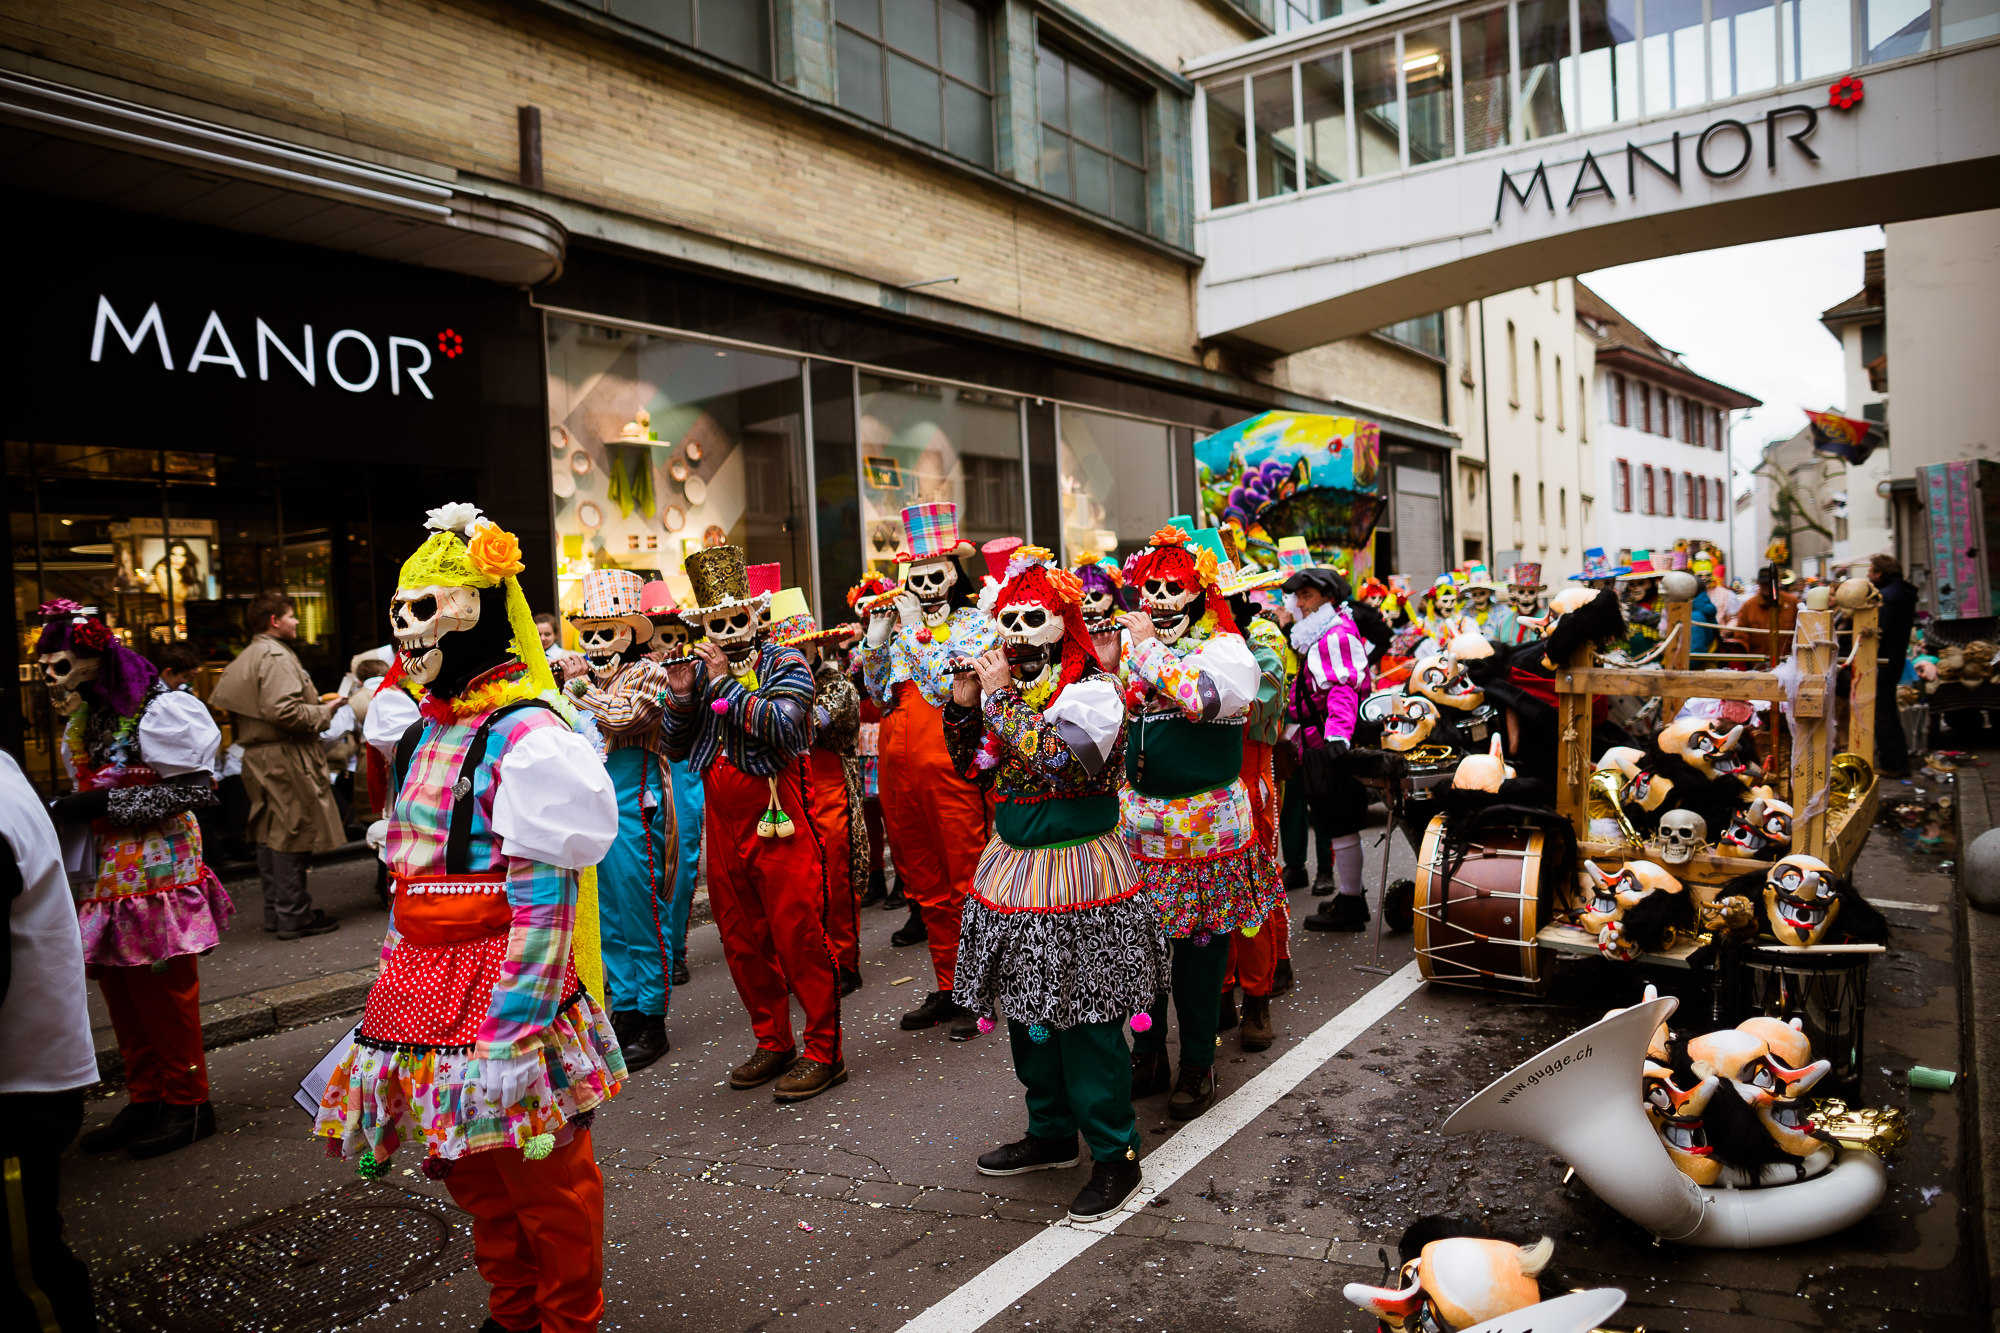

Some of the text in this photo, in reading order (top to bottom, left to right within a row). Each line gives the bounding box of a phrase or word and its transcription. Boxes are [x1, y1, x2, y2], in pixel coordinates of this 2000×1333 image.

[1495, 104, 1820, 223] MANOR
[91, 294, 434, 399] MANOR
[1498, 1044, 1593, 1105] www.gugge.ch
